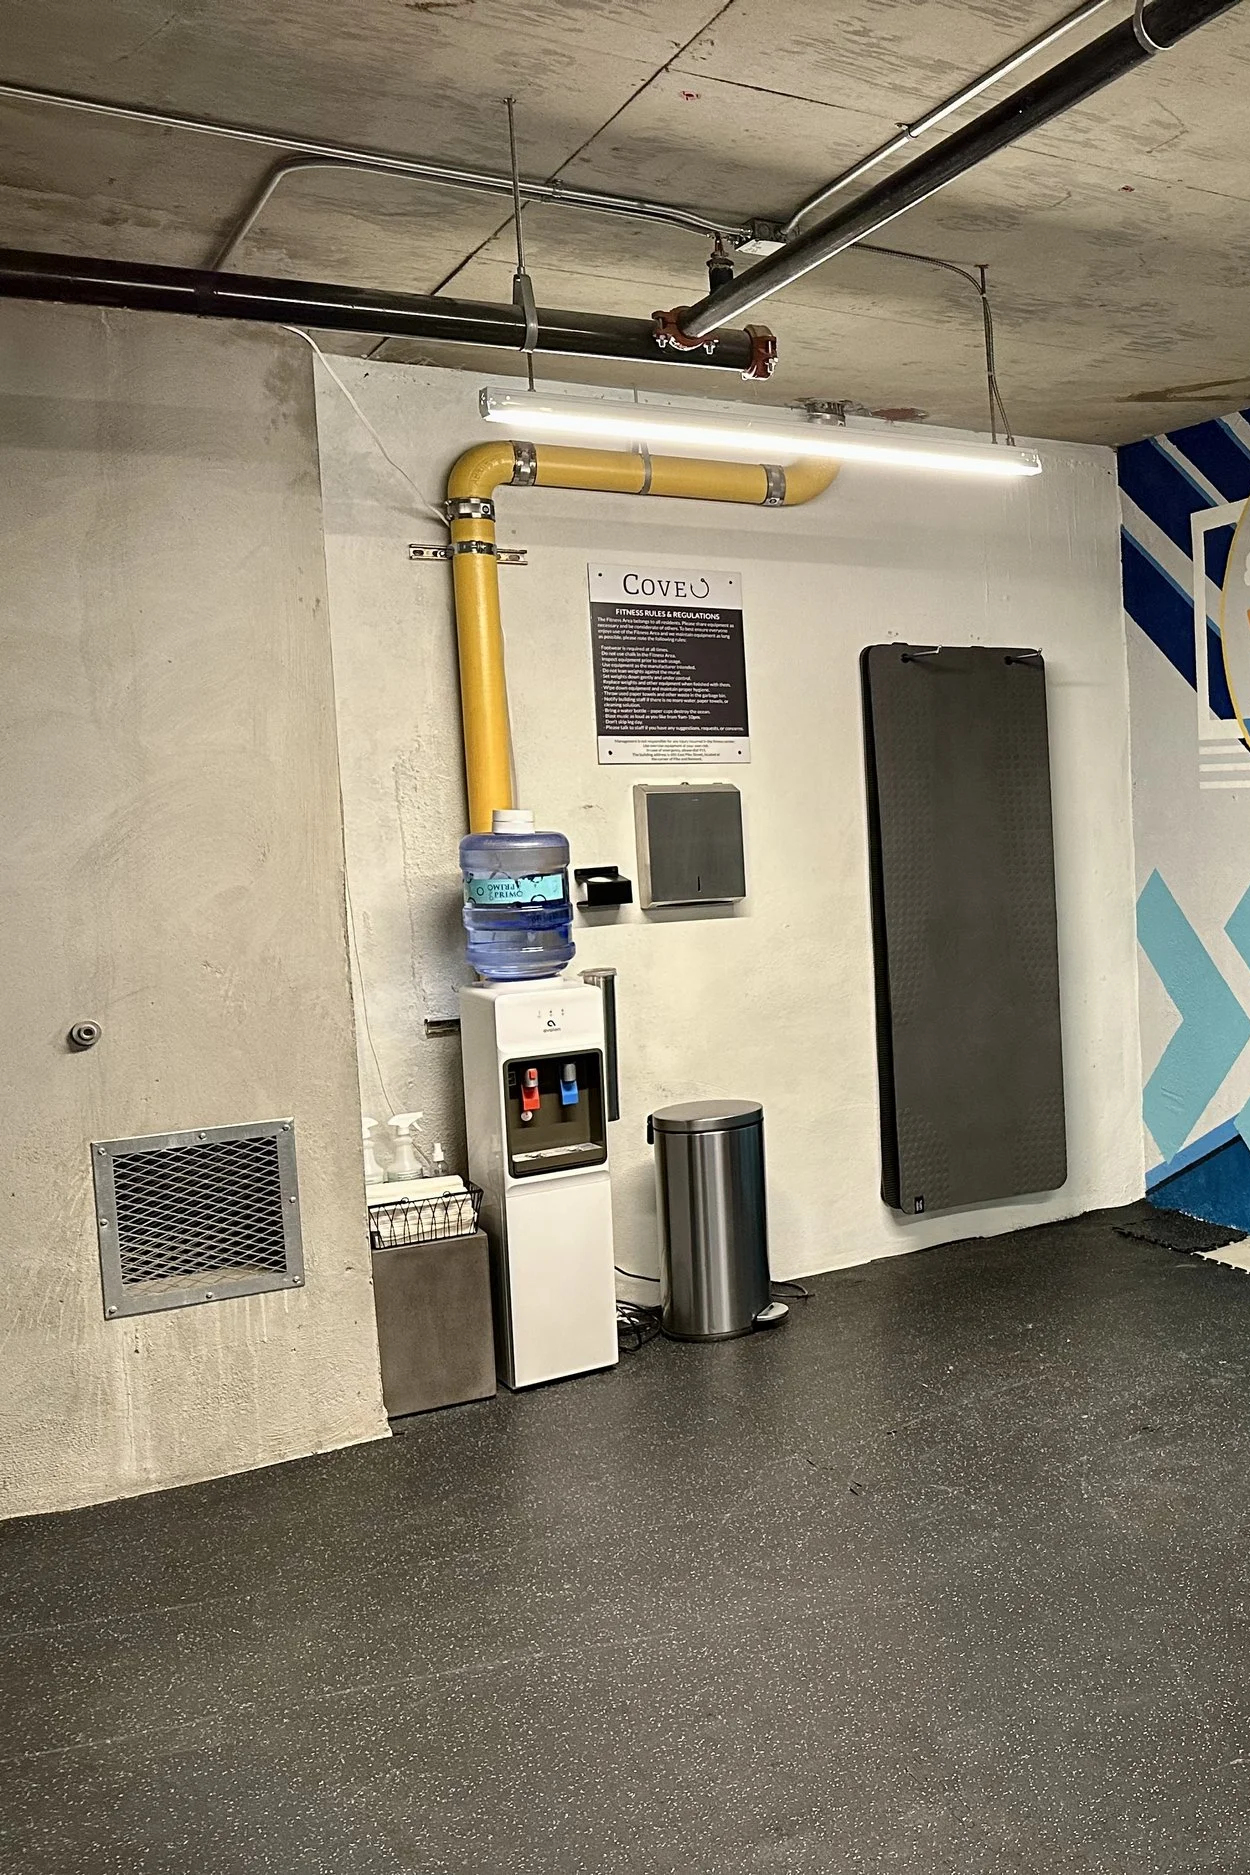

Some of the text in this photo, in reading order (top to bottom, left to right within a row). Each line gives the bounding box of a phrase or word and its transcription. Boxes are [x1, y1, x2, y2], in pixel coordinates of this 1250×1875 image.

[615, 608, 644, 616] FITNESS
[643, 609, 666, 617] RULES
[672, 610, 720, 620] REGULATIONS
